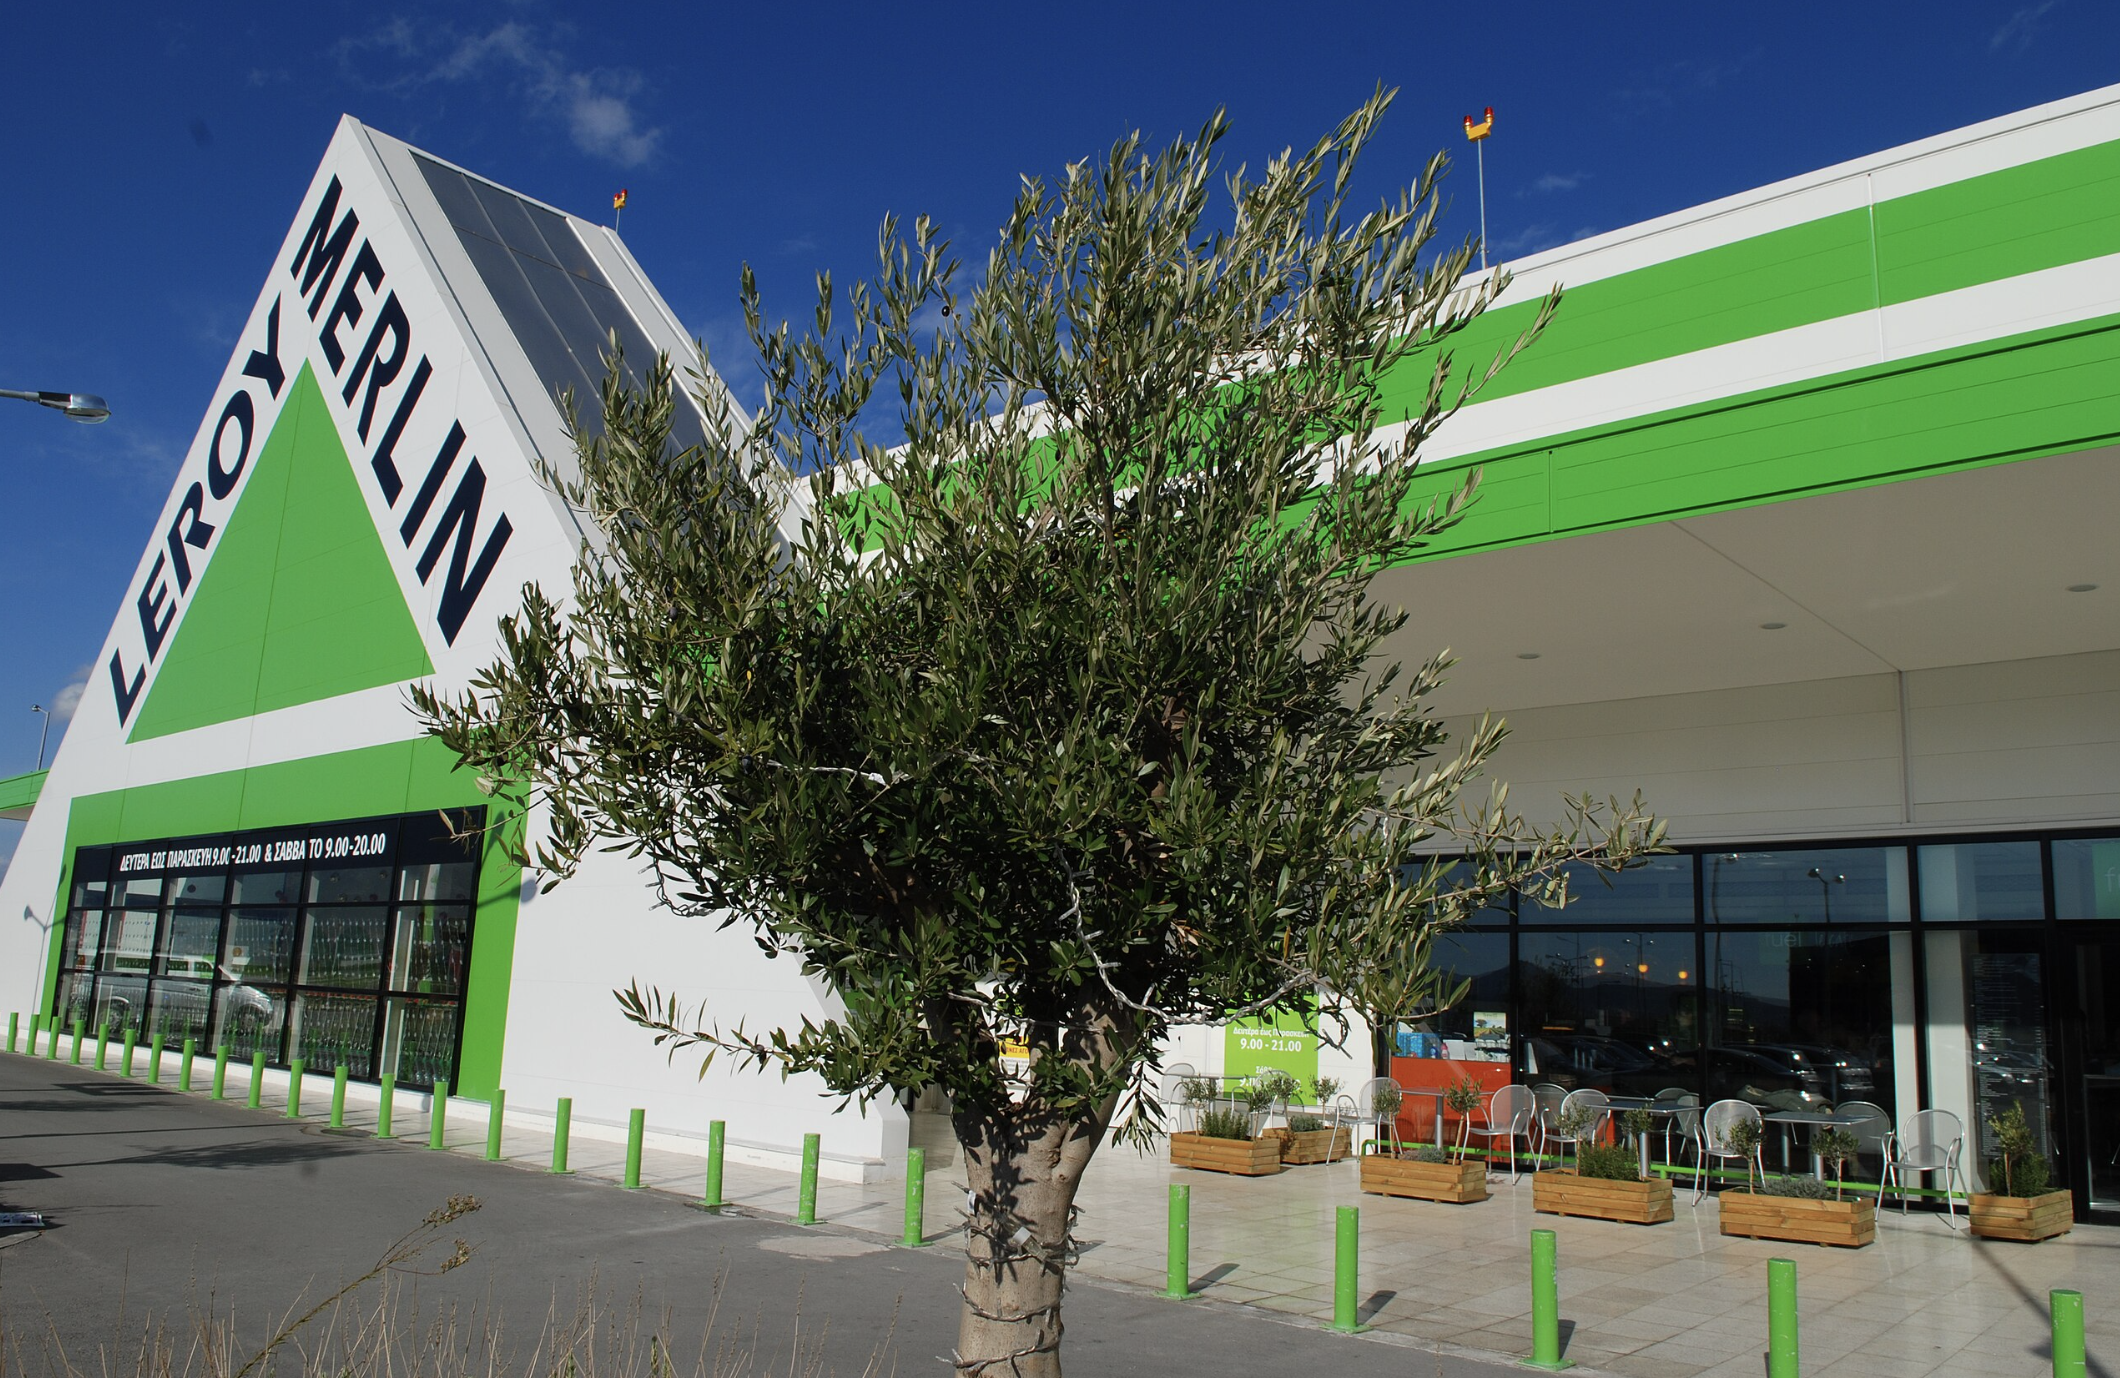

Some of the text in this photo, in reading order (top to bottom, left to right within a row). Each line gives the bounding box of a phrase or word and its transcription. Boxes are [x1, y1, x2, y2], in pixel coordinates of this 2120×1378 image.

[109, 173, 513, 728] LEROY MERLIN
[119, 853, 150, 872] ΔΕΥΤΕΡΑ
[151, 851, 167, 869] ΕΩΣ
[1240, 1038, 1263, 1050] 9.00
[1271, 1039, 1302, 1052] 21.00
